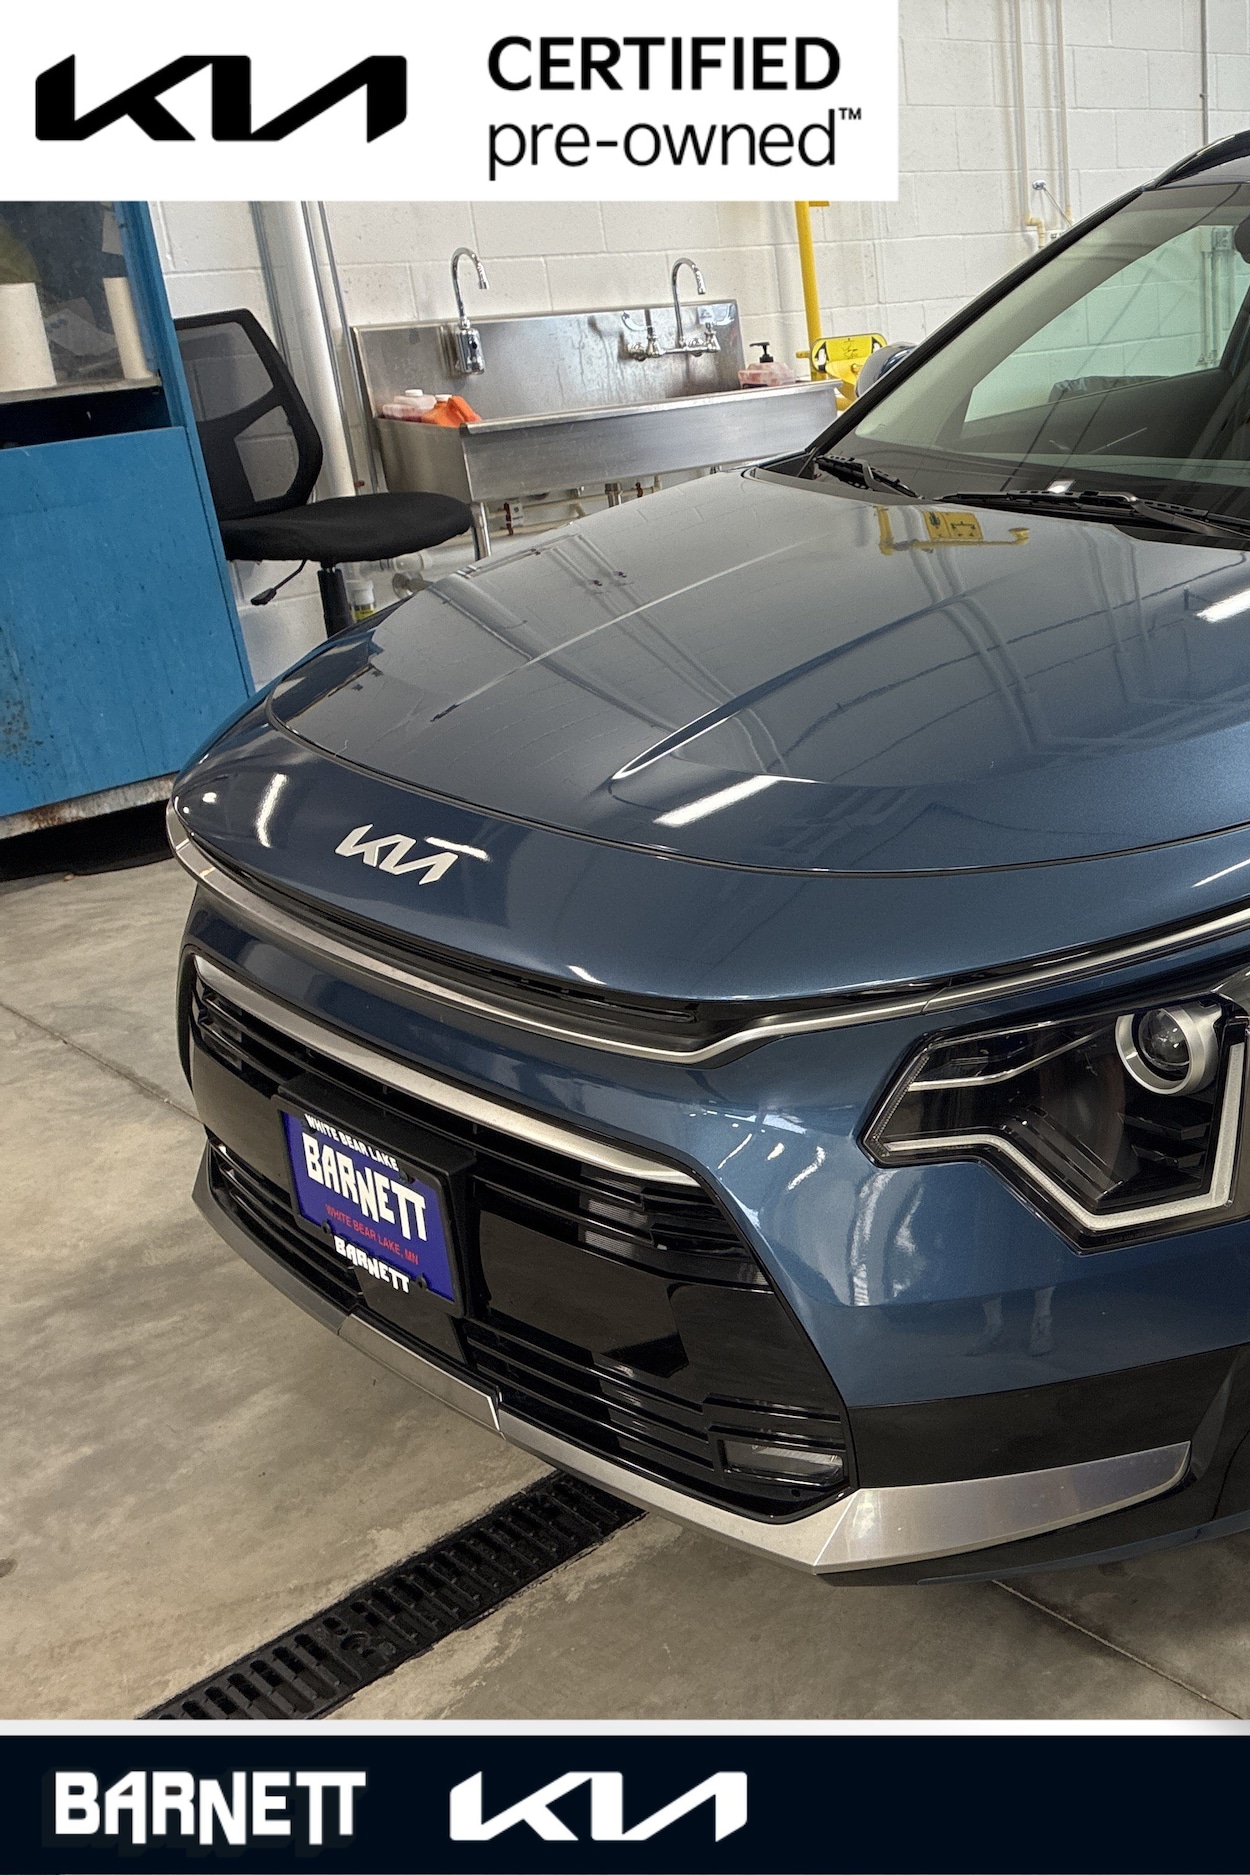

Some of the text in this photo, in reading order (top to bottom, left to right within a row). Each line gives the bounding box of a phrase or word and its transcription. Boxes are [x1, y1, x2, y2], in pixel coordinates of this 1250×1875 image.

[335, 823, 459, 886] KIA
[304, 1113, 400, 1172] WHITE BEAR LAKE
[302, 1132, 427, 1242] BARNETT
[325, 1203, 352, 1227] WHITE
[353, 1220, 377, 1243] BEAR
[404, 1247, 419, 1266] MN
[333, 1235, 410, 1294] BARNETT
